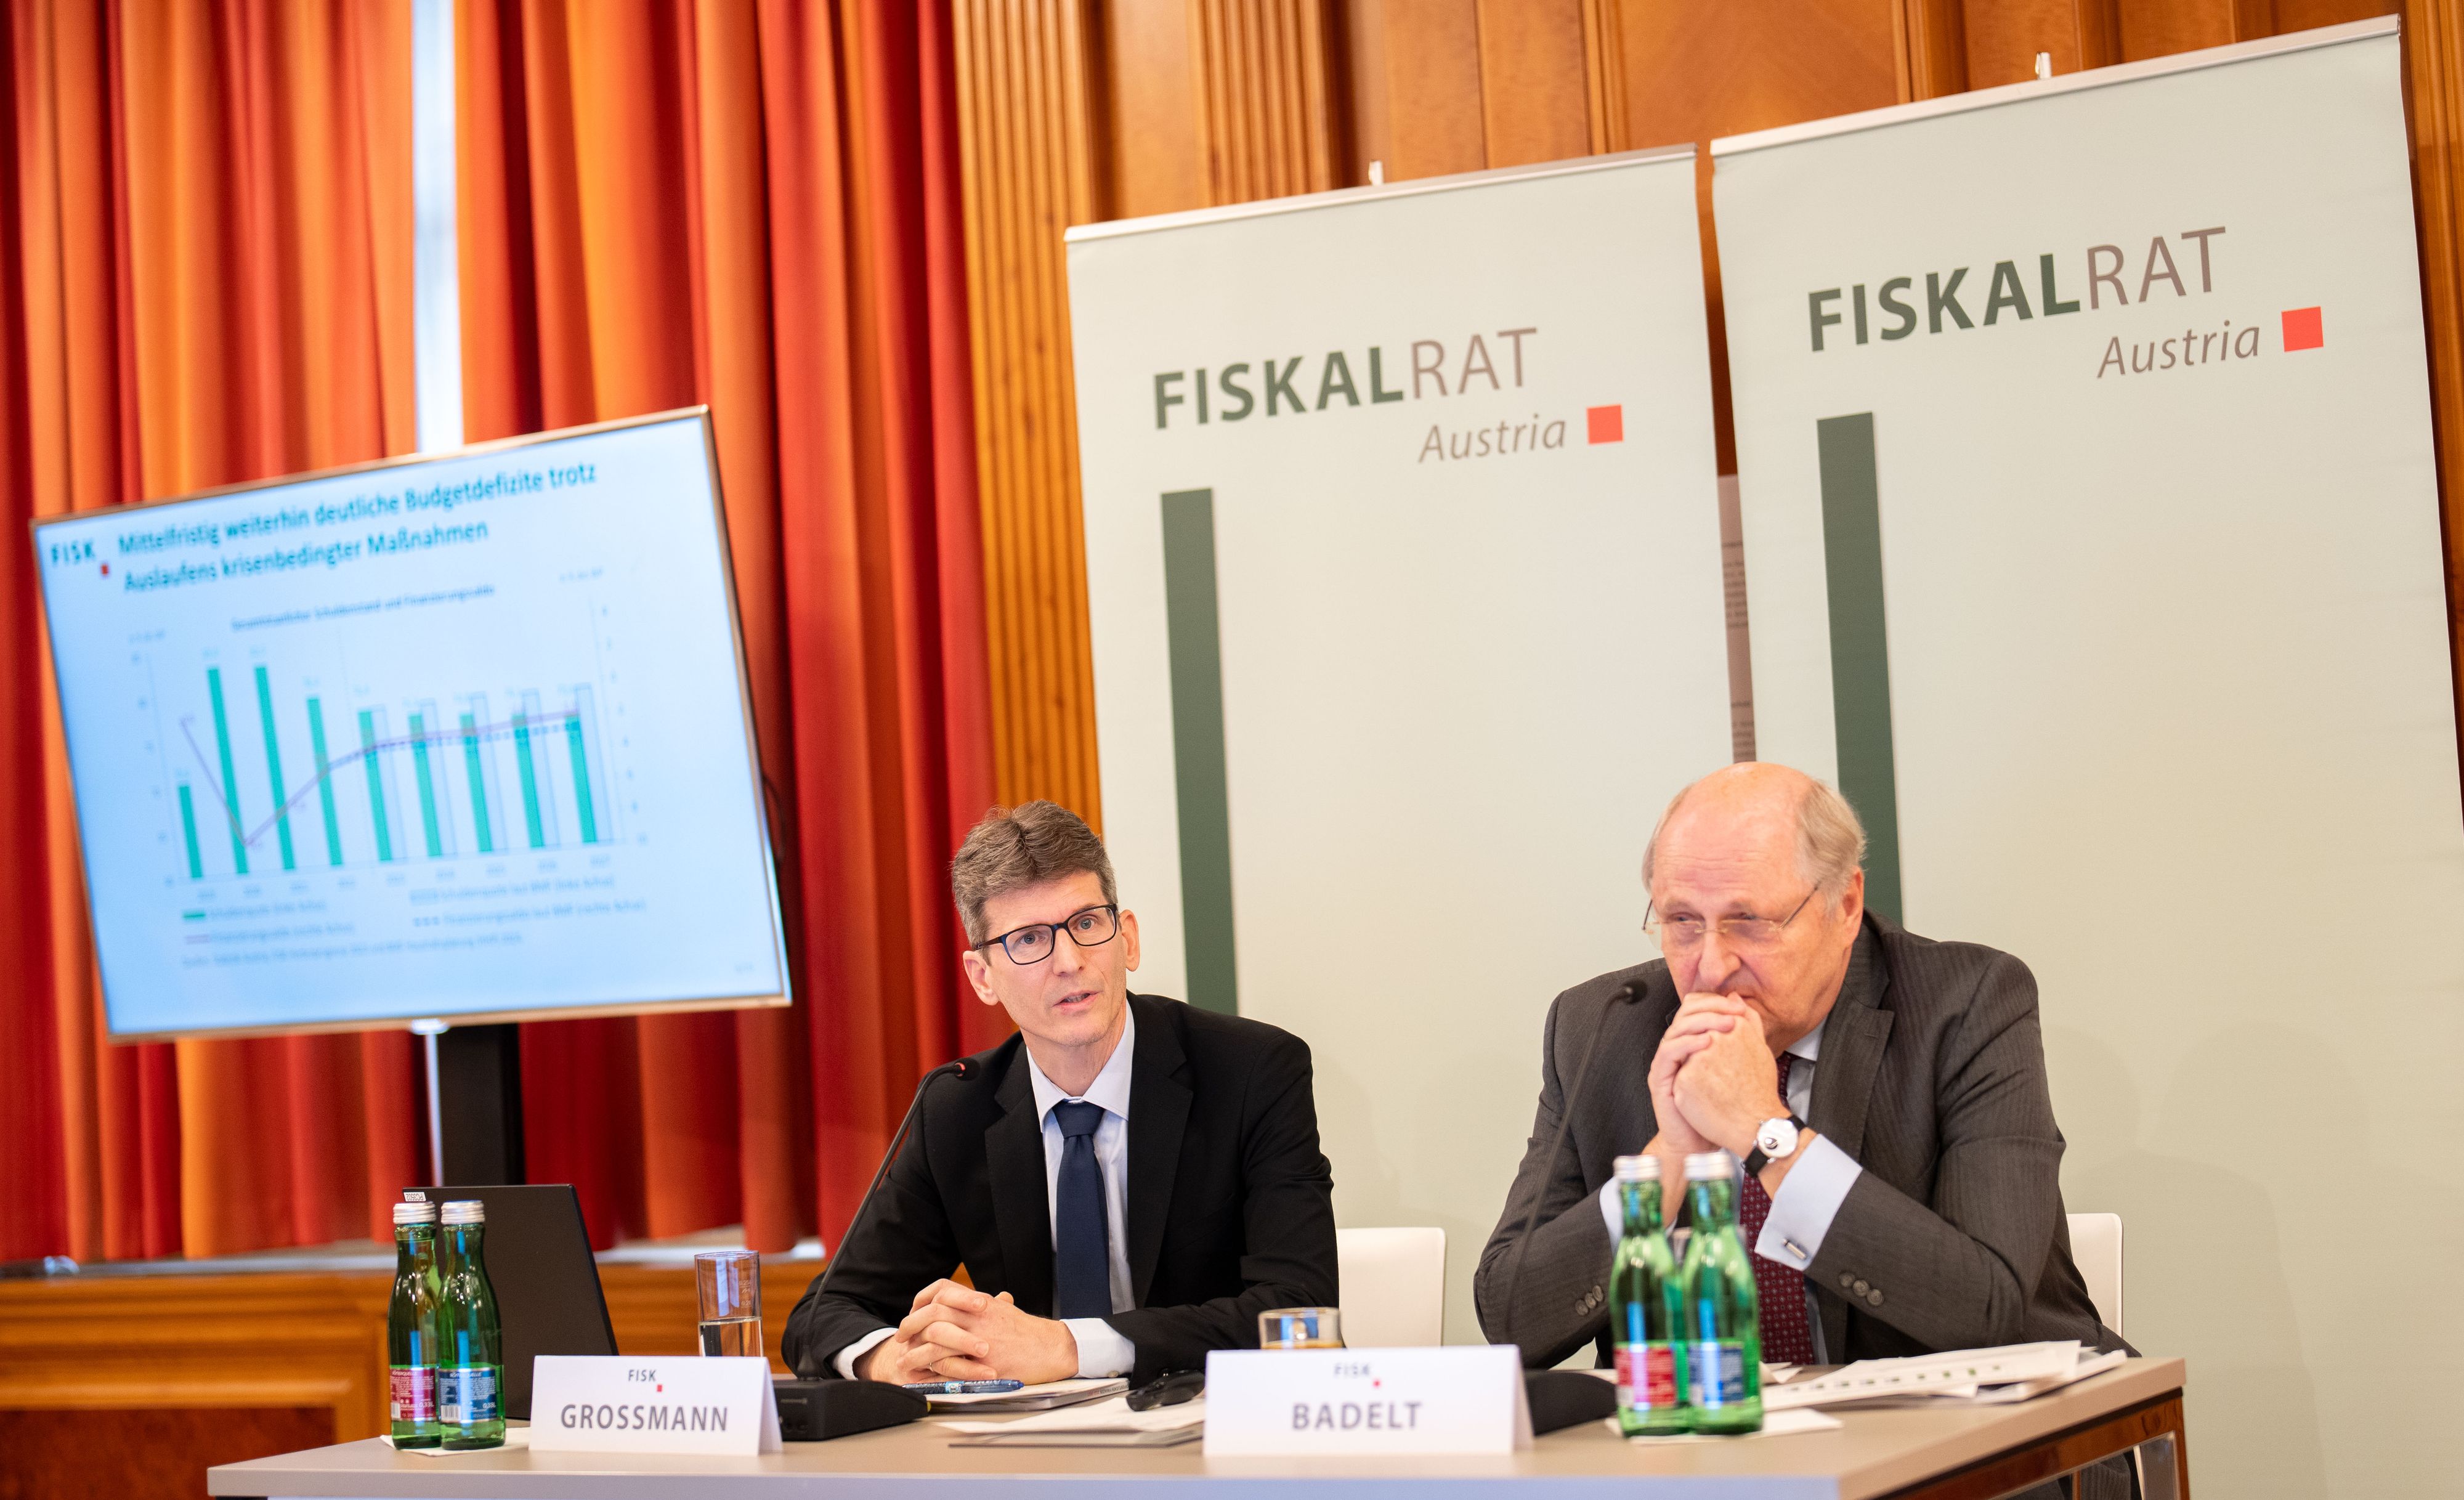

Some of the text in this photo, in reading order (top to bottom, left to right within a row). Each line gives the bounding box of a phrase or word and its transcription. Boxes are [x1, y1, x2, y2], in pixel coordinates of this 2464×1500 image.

[1808, 225, 2226, 352] FISKALRAT
[2096, 320, 2261, 379] Austria
[1154, 327, 1538, 429] FISKALRAT
[1418, 414, 1566, 463] Austria
[118, 463, 596, 554] Mittelfristig weiterhin deutliche Budgetdefizite trotz
[51, 540, 95, 566] FISK
[124, 521, 488, 591] Auslaufens krisenbedingter Maßnahmen
[628, 1369, 657, 1382] FISK
[1334, 1363, 1371, 1378] FISK
[561, 1404, 728, 1432] GROSSMANN
[1292, 1401, 1422, 1431] BADELT
